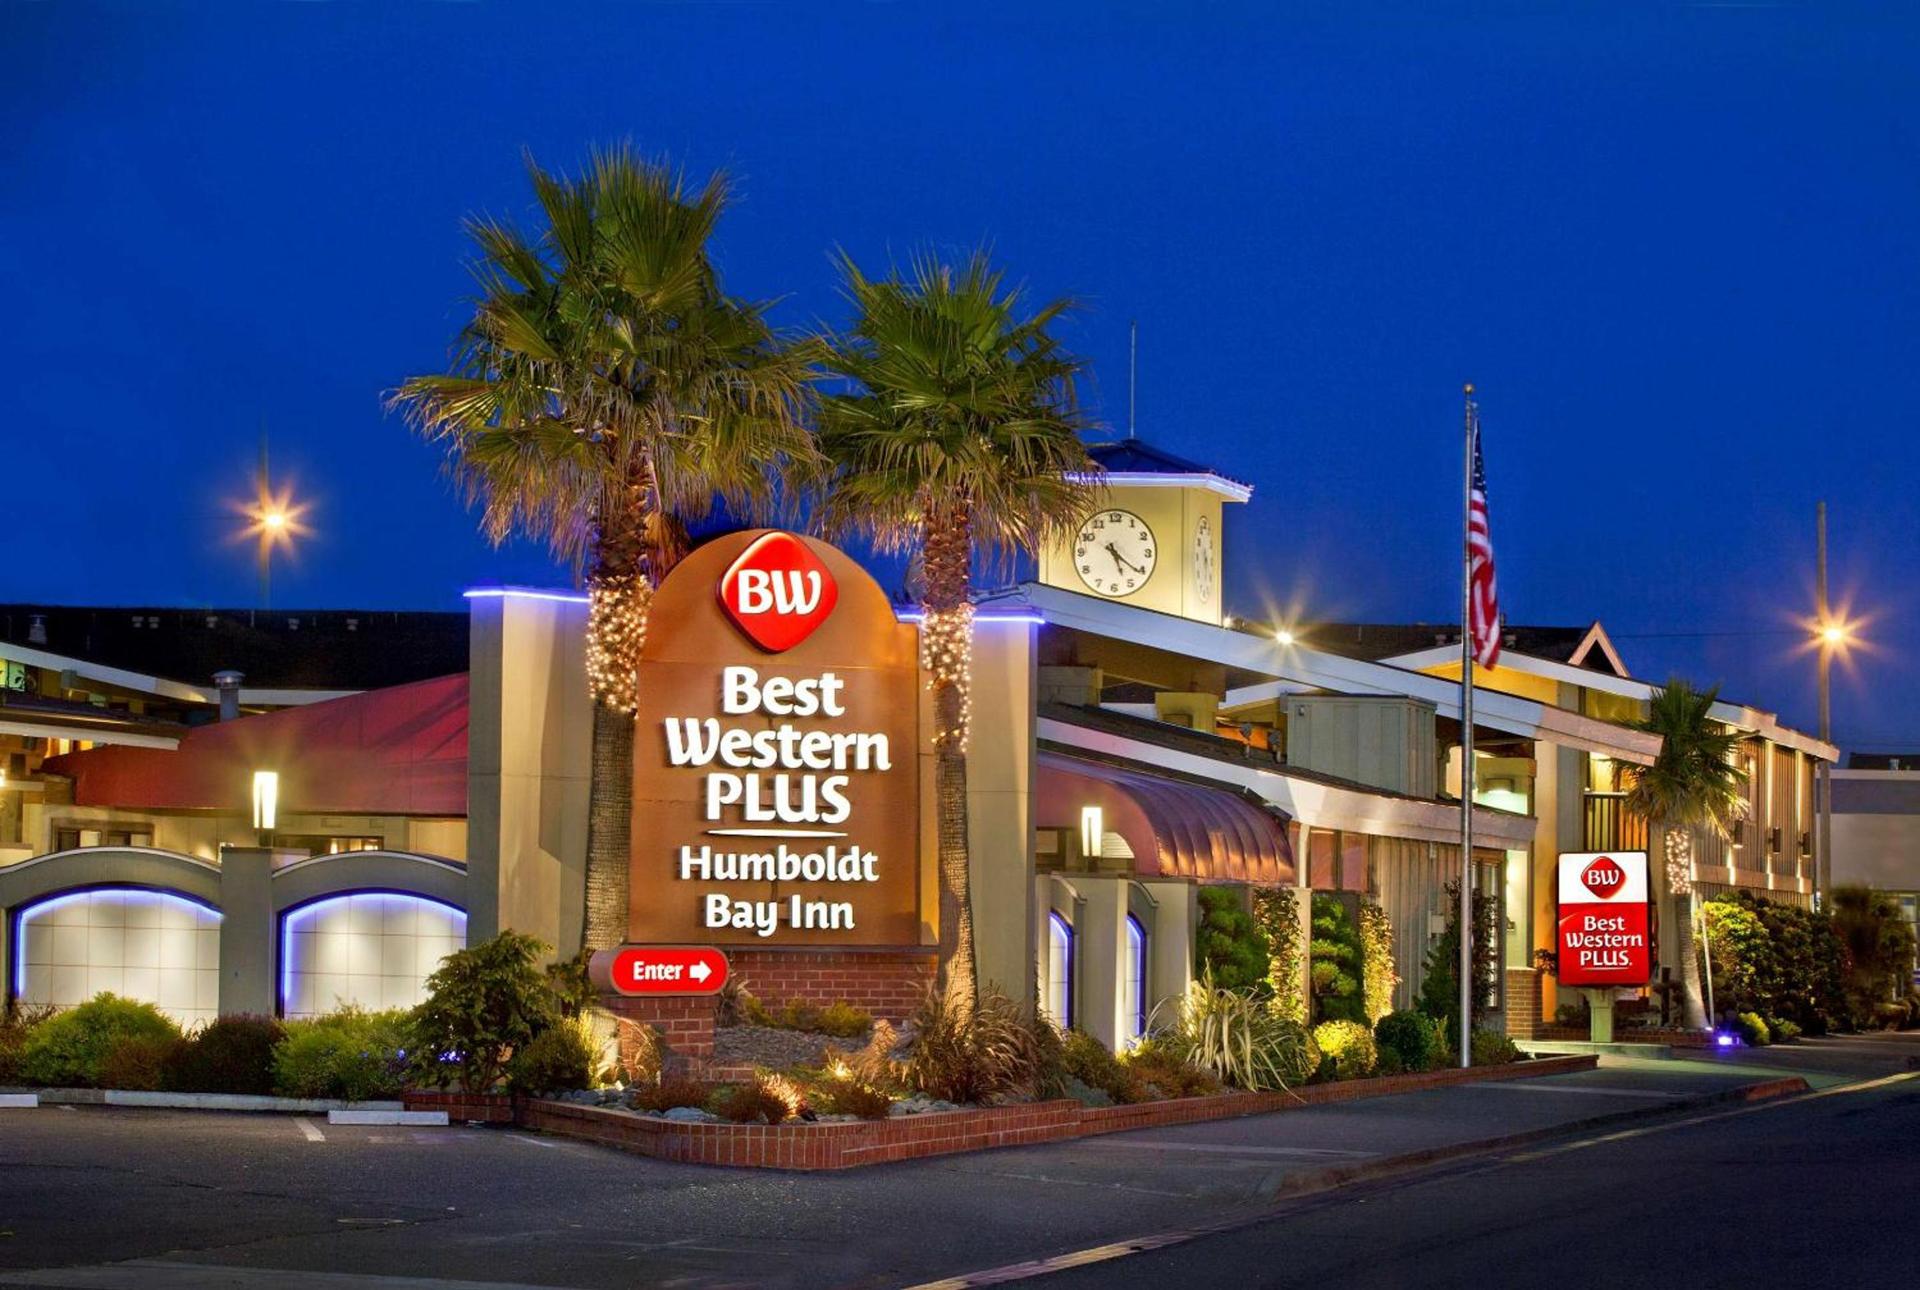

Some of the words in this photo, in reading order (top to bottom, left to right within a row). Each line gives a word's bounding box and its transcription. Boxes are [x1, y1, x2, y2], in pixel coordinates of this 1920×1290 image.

[1109, 513, 1122, 523] 12
[1092, 520, 1104, 529] 11
[1130, 520, 1135, 528] 1
[1082, 533, 1095, 542] 10
[1139, 532, 1148, 541] 2
[1077, 548, 1085, 557] 9
[1144, 548, 1152, 558] 3
[1082, 565, 1090, 574] 8
[1095, 579, 1103, 588] 7
[1110, 583, 1118, 592] 6
[1127, 579, 1135, 588] 5
[738, 570, 822, 616] BW
[723, 666, 845, 717] Best
[665, 718, 892, 771] Western
[706, 773, 852, 824] PLUS
[681, 846, 880, 882] Humboldt
[1587, 869, 1620, 885] BW
[705, 895, 778, 938] Bay
[791, 894, 856, 930] Inn
[1584, 916, 1625, 931] Best
[1565, 932, 1643, 948] Western
[633, 961, 684, 982] Enter
